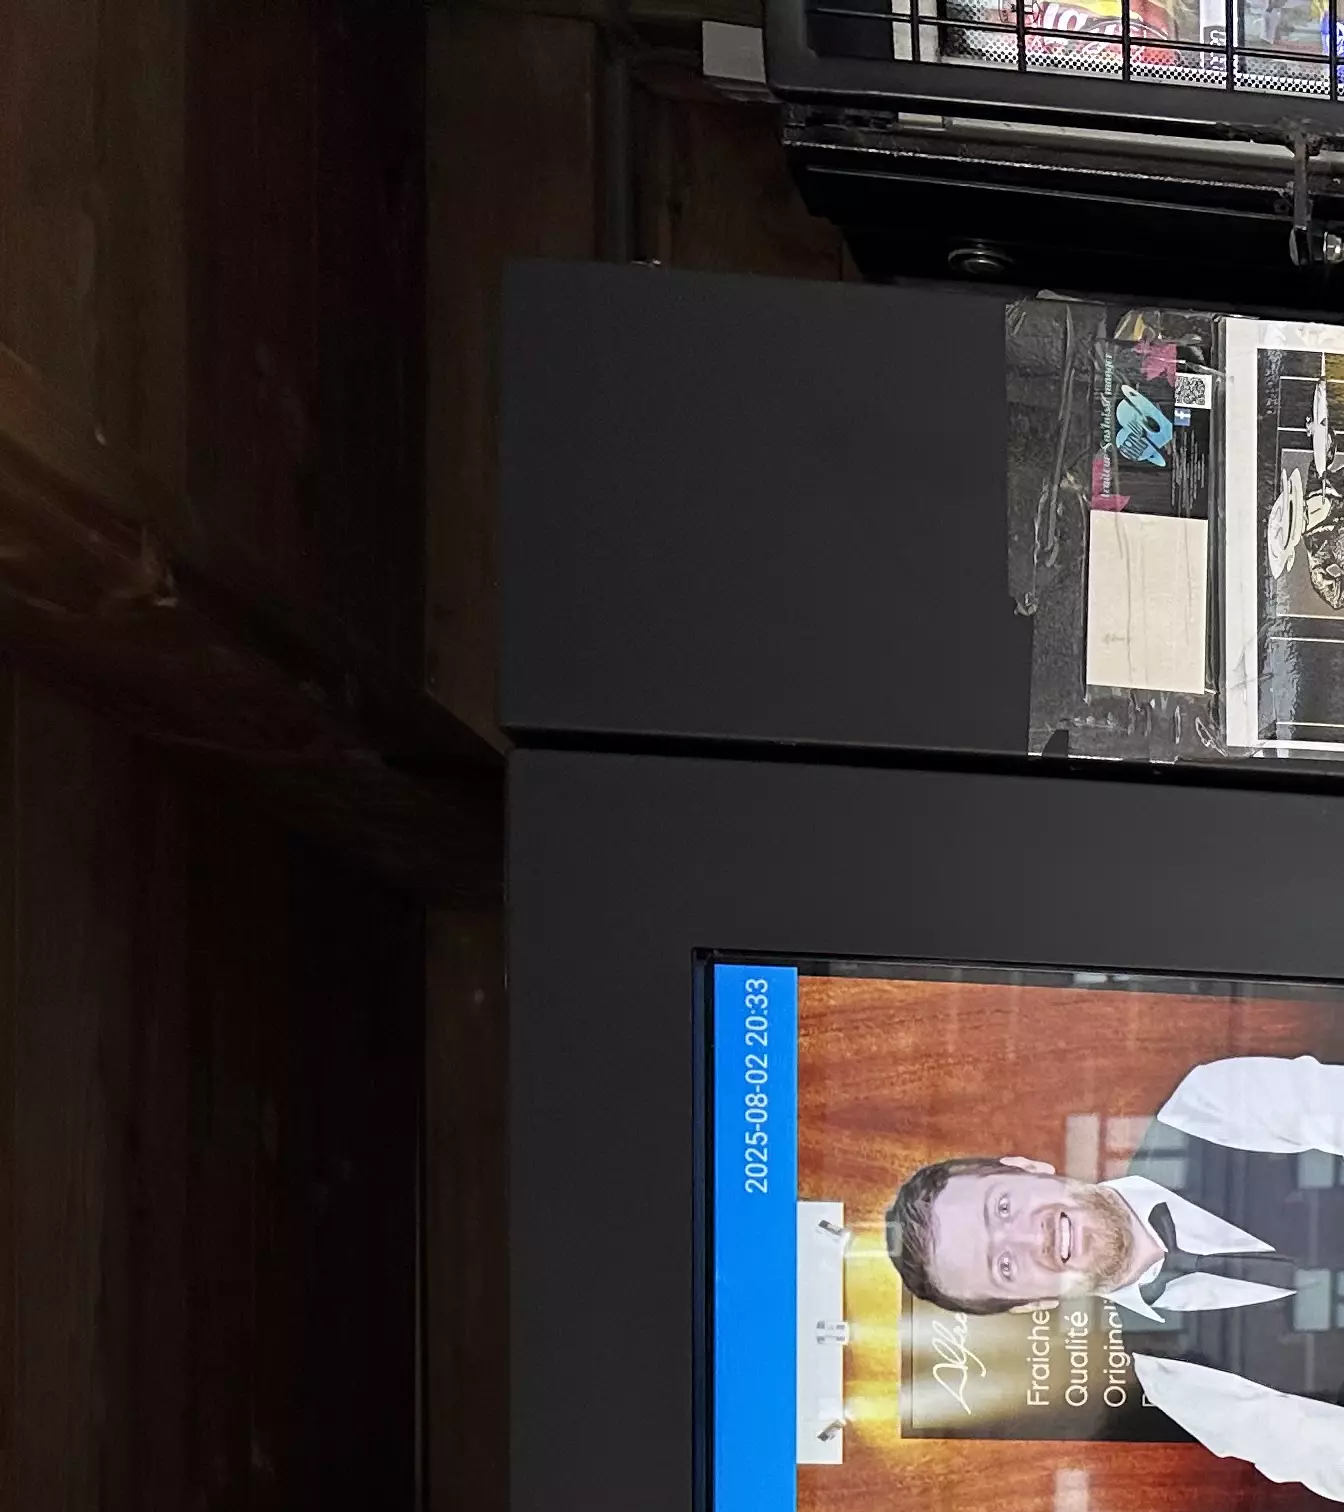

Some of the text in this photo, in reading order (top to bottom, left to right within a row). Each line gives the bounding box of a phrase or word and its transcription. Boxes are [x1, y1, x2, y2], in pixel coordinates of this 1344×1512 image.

[743, 978, 771, 1194] 2025-08-02 20:33
[932, 1313, 986, 1415] Alfre
[1064, 1311, 1088, 1406] Qualité
